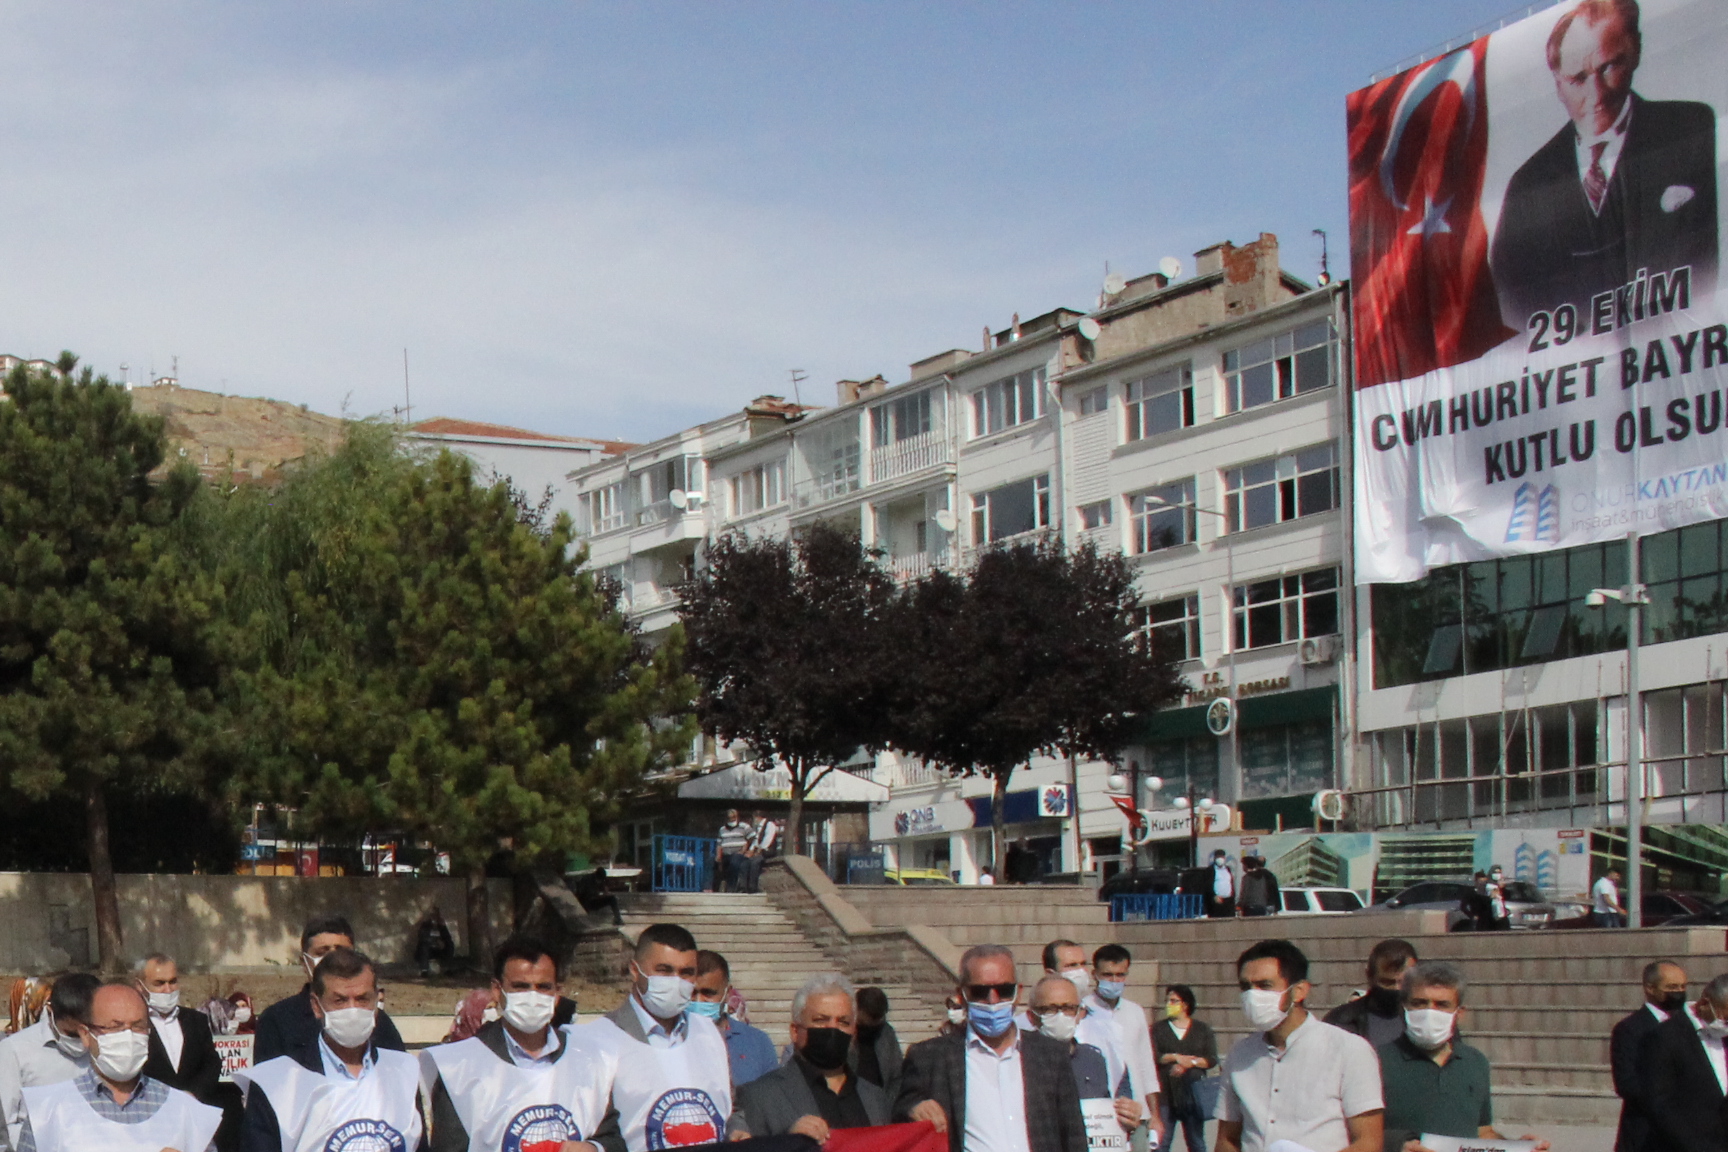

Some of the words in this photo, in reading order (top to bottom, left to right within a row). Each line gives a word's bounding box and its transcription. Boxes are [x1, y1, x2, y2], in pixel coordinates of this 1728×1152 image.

[1528, 303, 1576, 353] 29
[1591, 266, 1692, 337] EKİM
[1372, 356, 1605, 453] CUMHURİYET
[1484, 420, 1595, 485] KUTLU
[1614, 389, 1728, 454] OLSU
[328, 1122, 402, 1152] MEMUR-SEN
[652, 1091, 717, 1121] MEMUR-SEN
